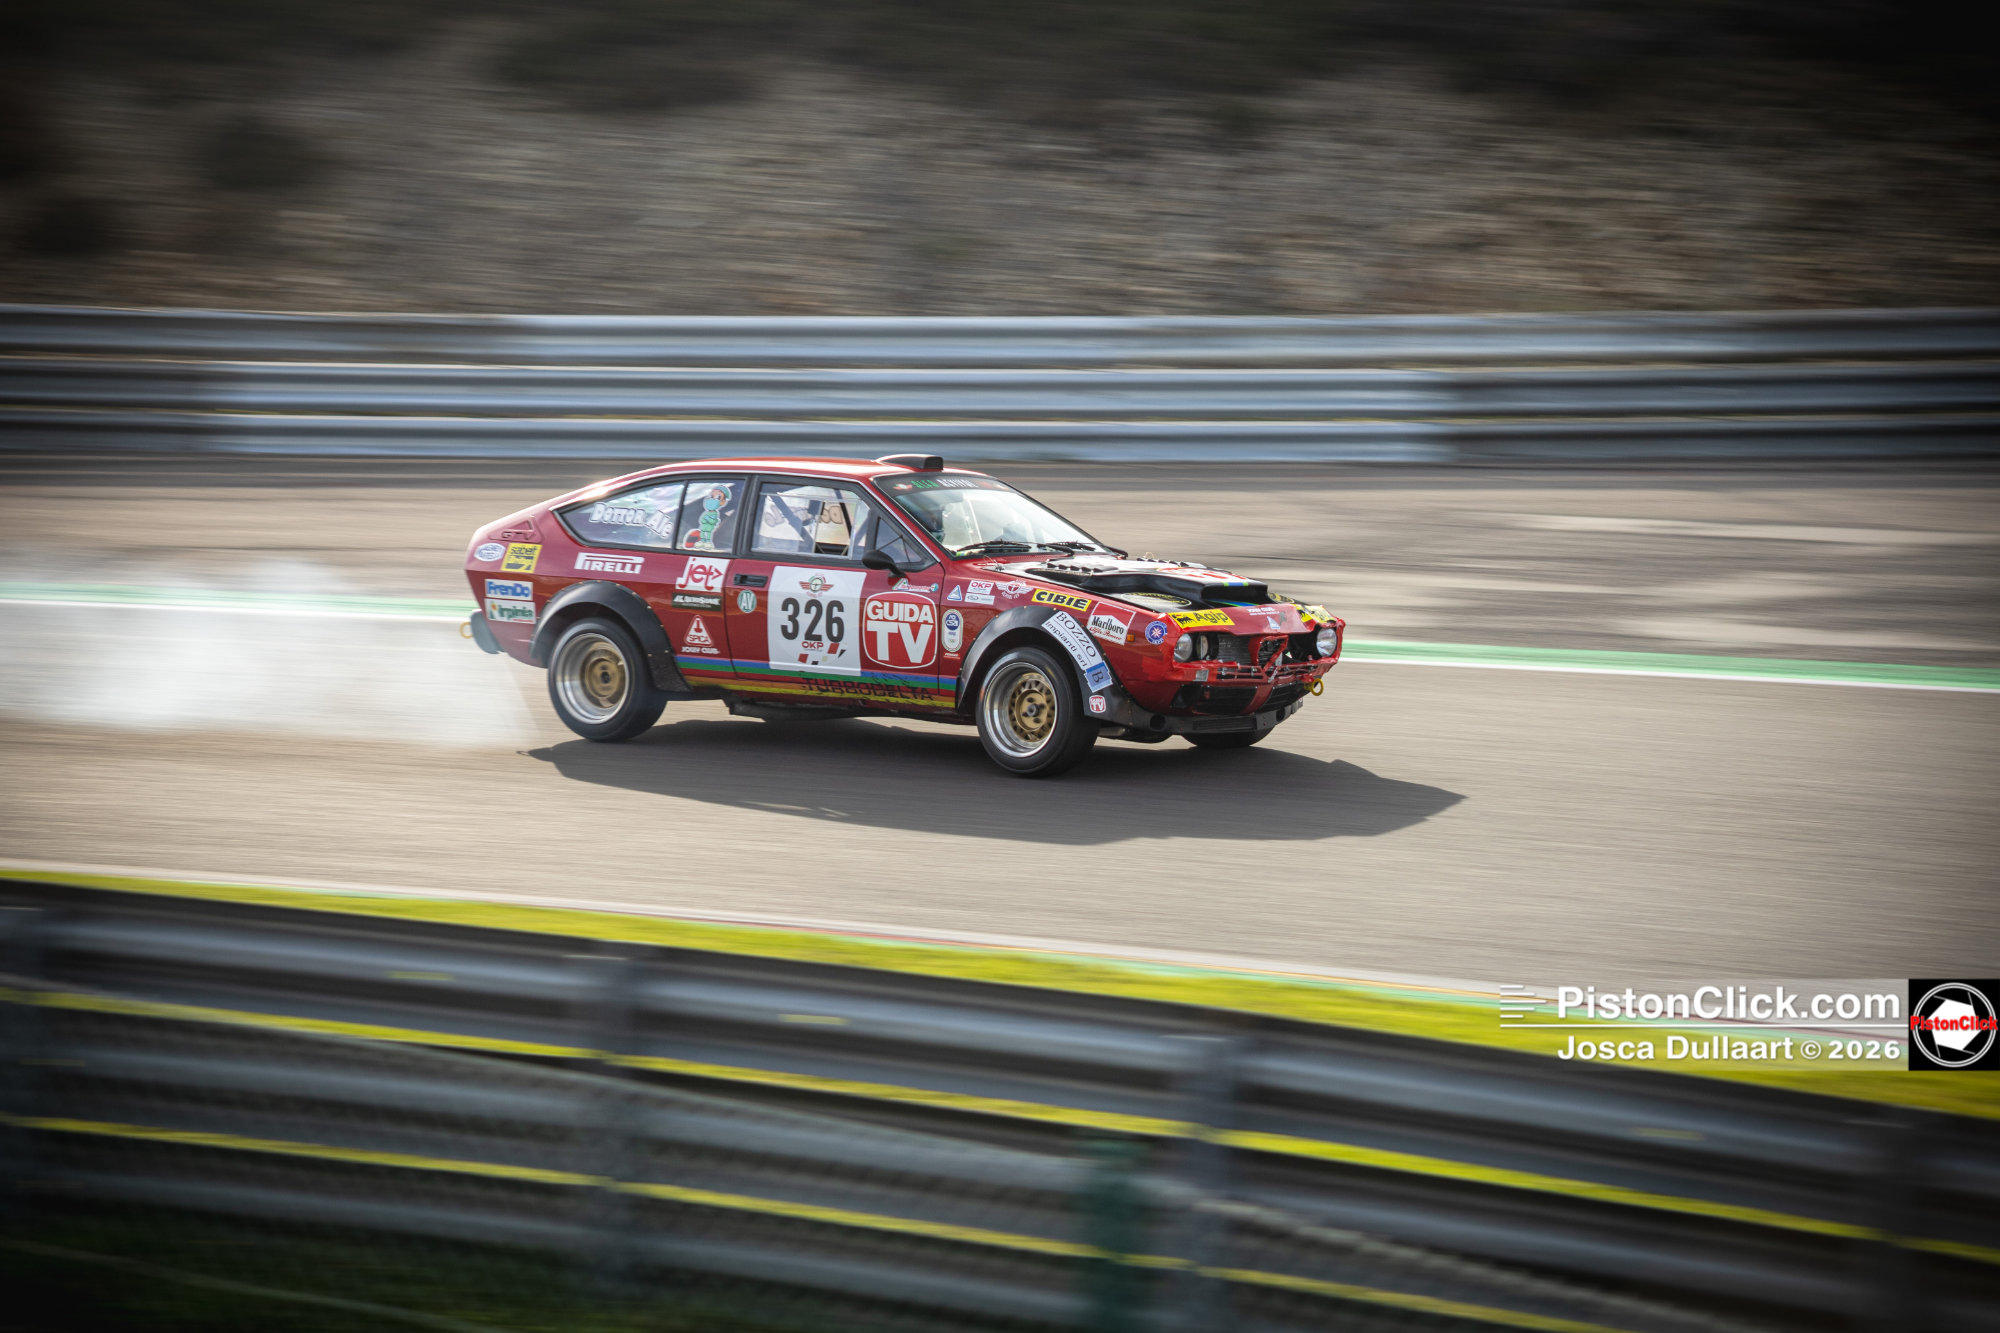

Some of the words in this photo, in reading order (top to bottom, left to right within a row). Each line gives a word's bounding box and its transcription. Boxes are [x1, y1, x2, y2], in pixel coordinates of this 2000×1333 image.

[574, 552, 645, 574] PIRELLI
[678, 557, 716, 591] jet
[971, 581, 992, 589] OKP
[1035, 591, 1088, 610] CIBIE
[781, 597, 844, 642] 326
[867, 601, 934, 624] GUIDA
[1193, 611, 1229, 624] Agip
[1091, 614, 1124, 635] Marlboro
[801, 640, 824, 650] OKP
[867, 620, 933, 664] TV
[1056, 613, 1097, 658] BOZZO
[1091, 671, 1104, 683] B
[1090, 702, 1104, 711] TV
